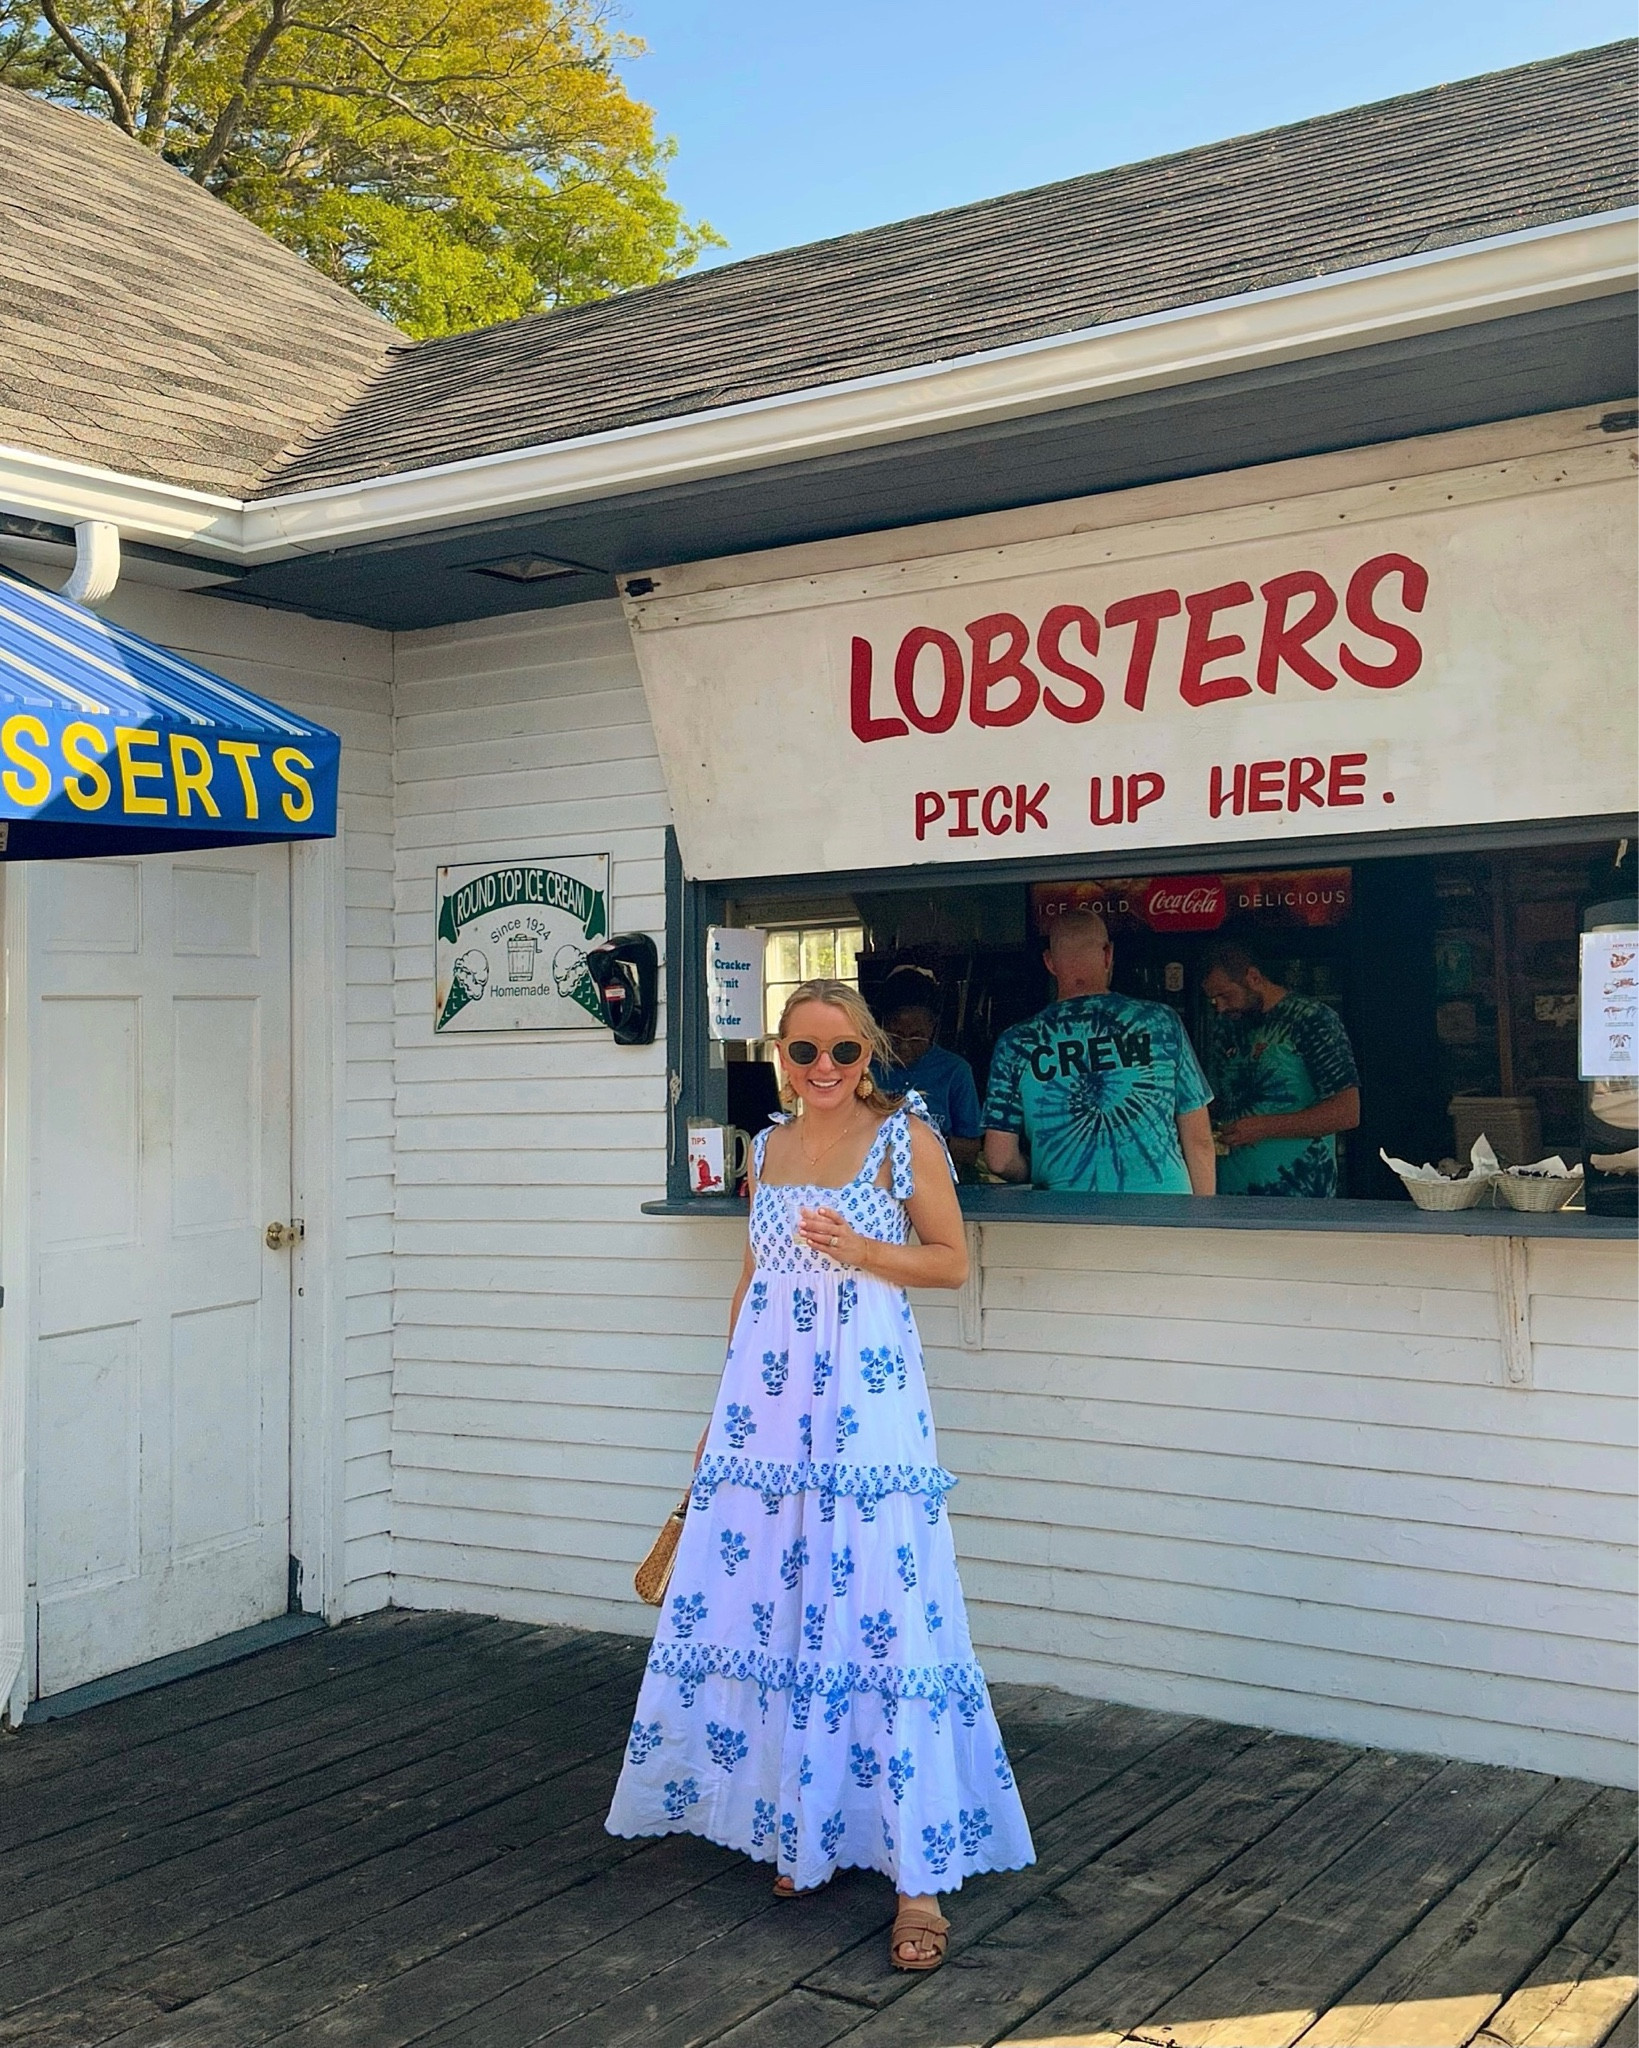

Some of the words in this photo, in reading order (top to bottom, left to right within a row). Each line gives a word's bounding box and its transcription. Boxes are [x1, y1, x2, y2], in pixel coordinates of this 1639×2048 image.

[851, 553, 1429, 743] LOBSTERS
[1, 715, 314, 822] SSERTS
[915, 782, 1050, 841] PICK
[1090, 772, 1165, 826] UP
[457, 876, 497, 924] ROUND
[498, 870, 522, 903] TOP
[525, 870, 543, 902] ICE
[546, 872, 586, 919] CREAM
[1149, 888, 1220, 915] Coca-Cola
[1238, 891, 1346, 908] DELICIOUS
[490, 918, 521, 943] Since
[526, 917, 552, 941] 1924
[715, 959, 751, 970] Cracker
[490, 984, 550, 998] Homemade
[715, 1014, 741, 1025] Order
[1030, 1032, 1152, 1082] CREW
[691, 1137, 706, 1145] TIPS
